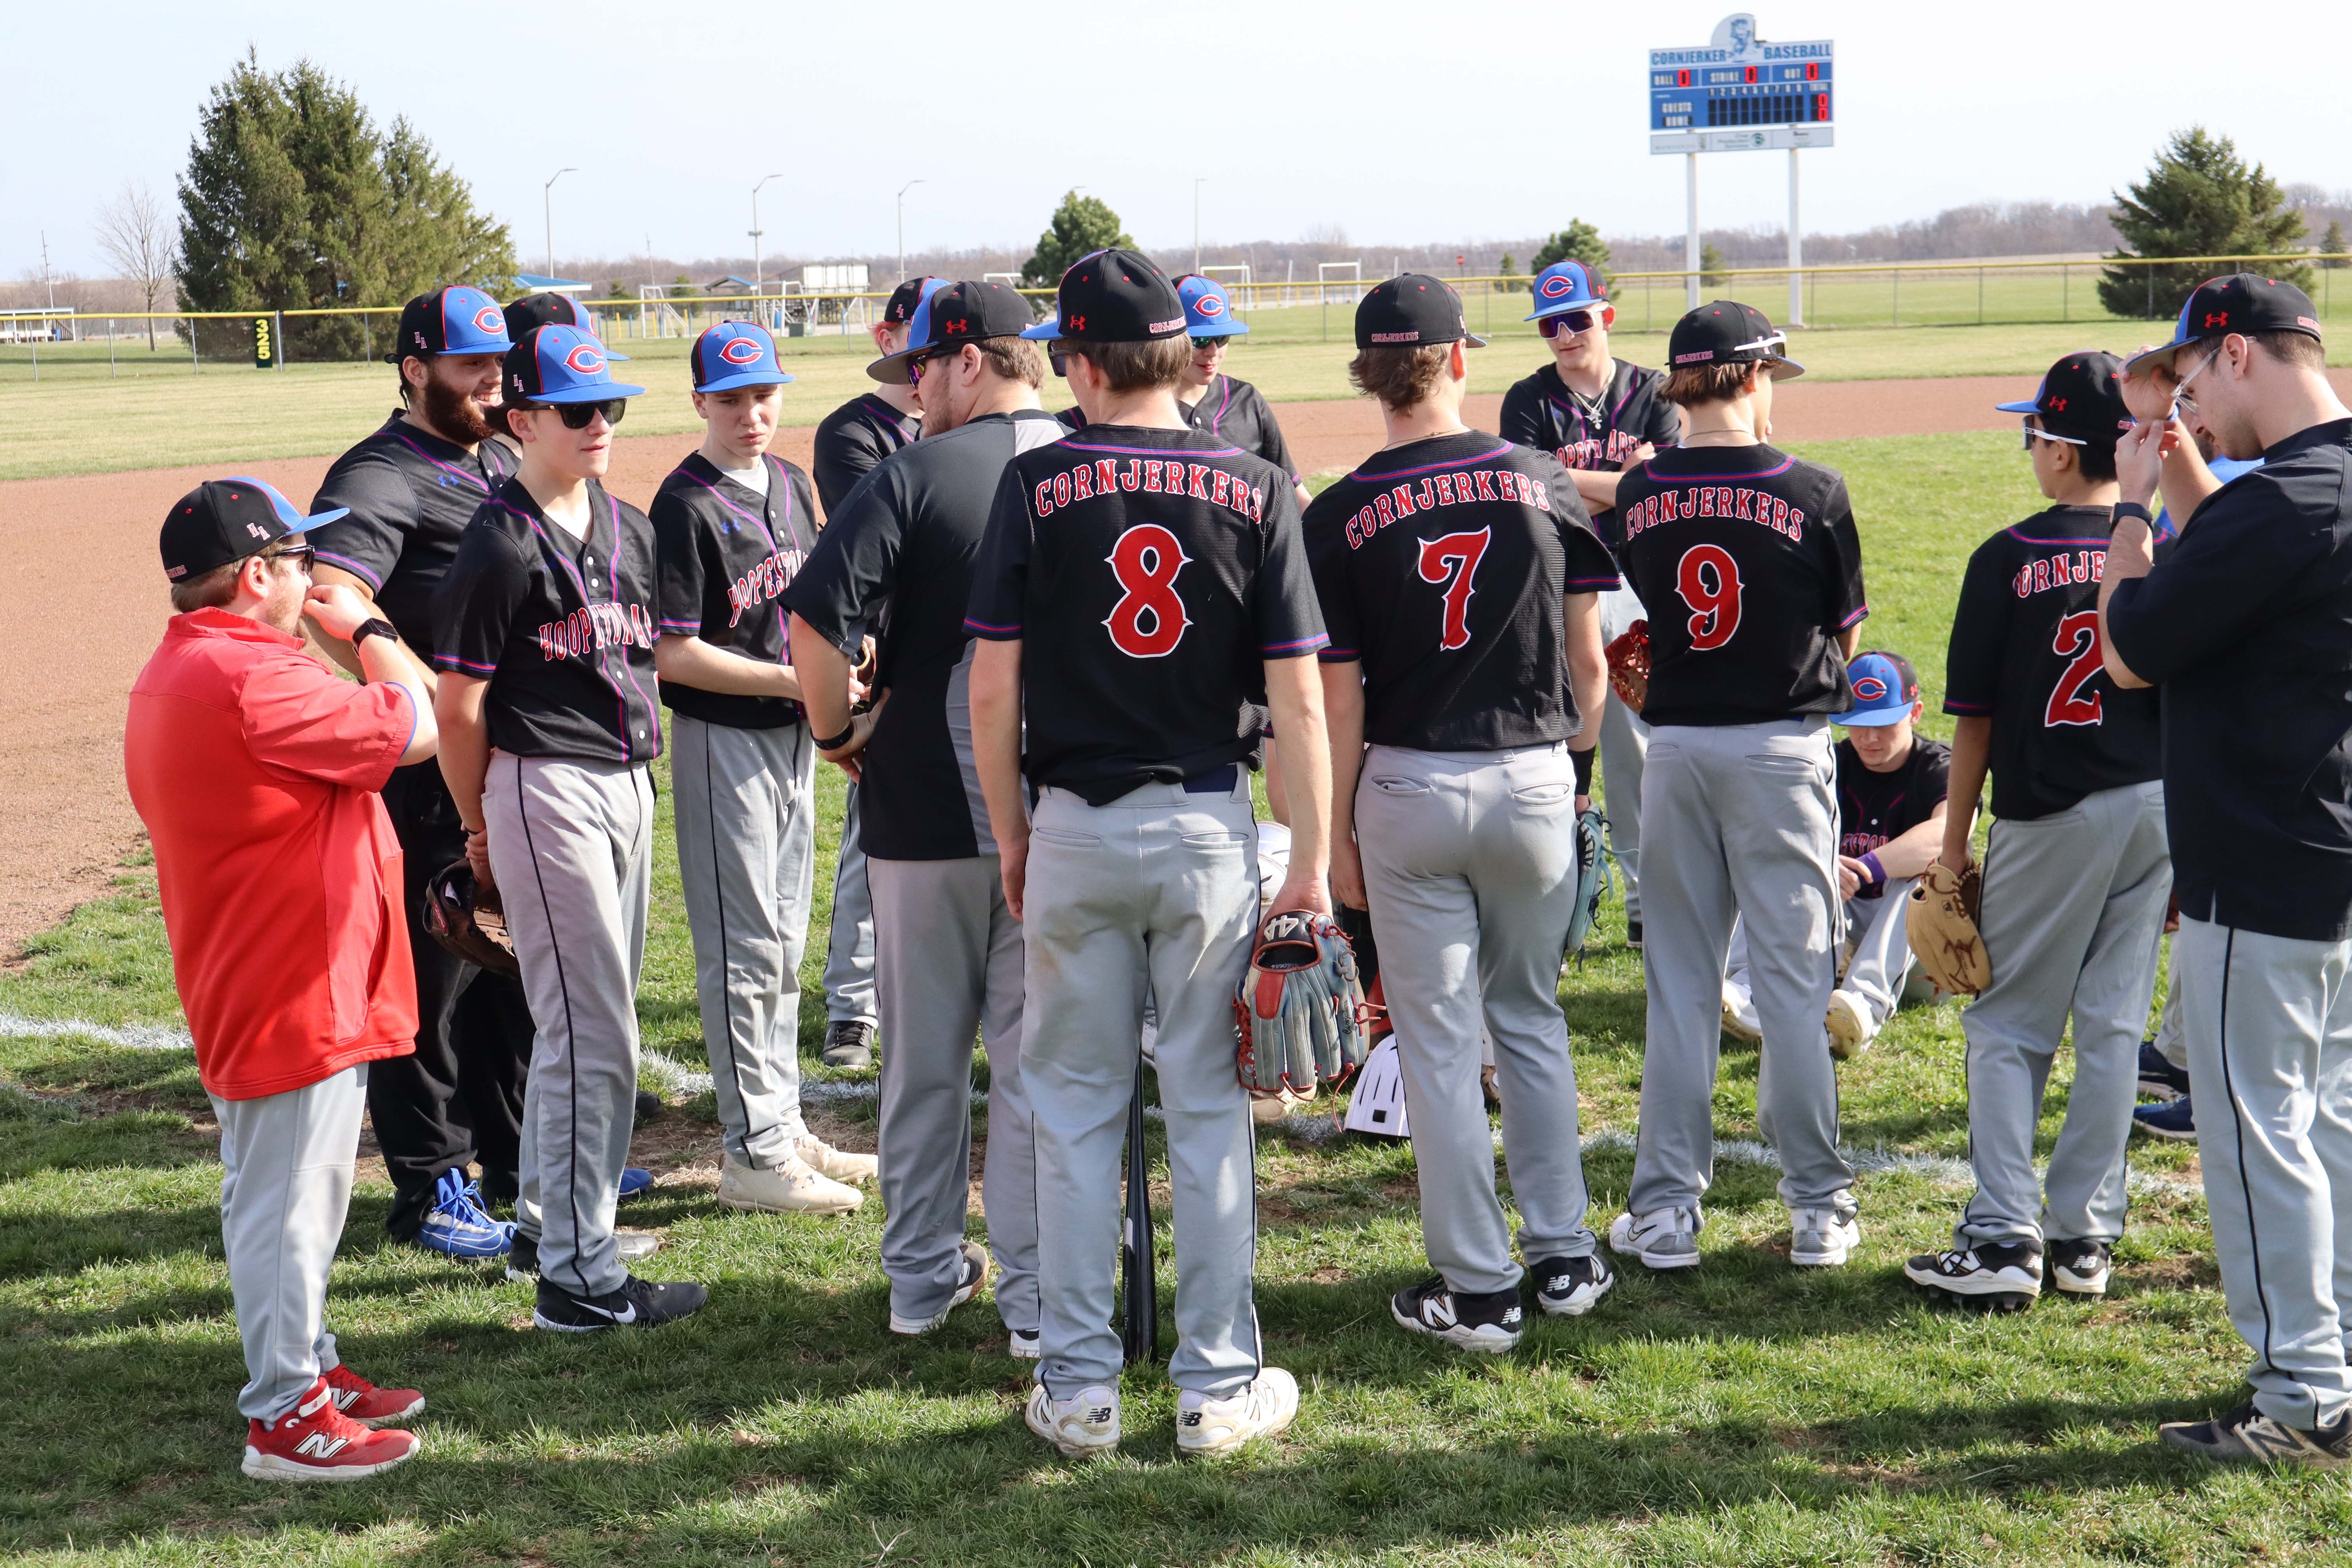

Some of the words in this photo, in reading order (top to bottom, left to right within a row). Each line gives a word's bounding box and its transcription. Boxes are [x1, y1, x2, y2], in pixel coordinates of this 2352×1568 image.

[1764, 44, 1830, 59] BASEBALL
[1678, 69, 1691, 87] 0
[1745, 66, 1758, 83] 0
[1806, 63, 1819, 81] 0
[1817, 107, 1828, 121] 0
[1818, 93, 1828, 107] 0
[1540, 276, 1573, 298] C
[1192, 294, 1224, 317] C
[472, 307, 506, 335] C
[256, 319, 270, 360] 325
[718, 337, 764, 365] C
[563, 344, 605, 375] C
[1036, 459, 1263, 524] CORNJERKERS
[1345, 471, 1550, 550] CORNJERKERS
[1626, 487, 1804, 541] CORNJERKERS
[1101, 524, 1194, 658] 8
[1417, 524, 1490, 652] 7
[1675, 544, 1745, 651] 9
[2045, 610, 2103, 728] 2
[1853, 677, 1887, 701] C
